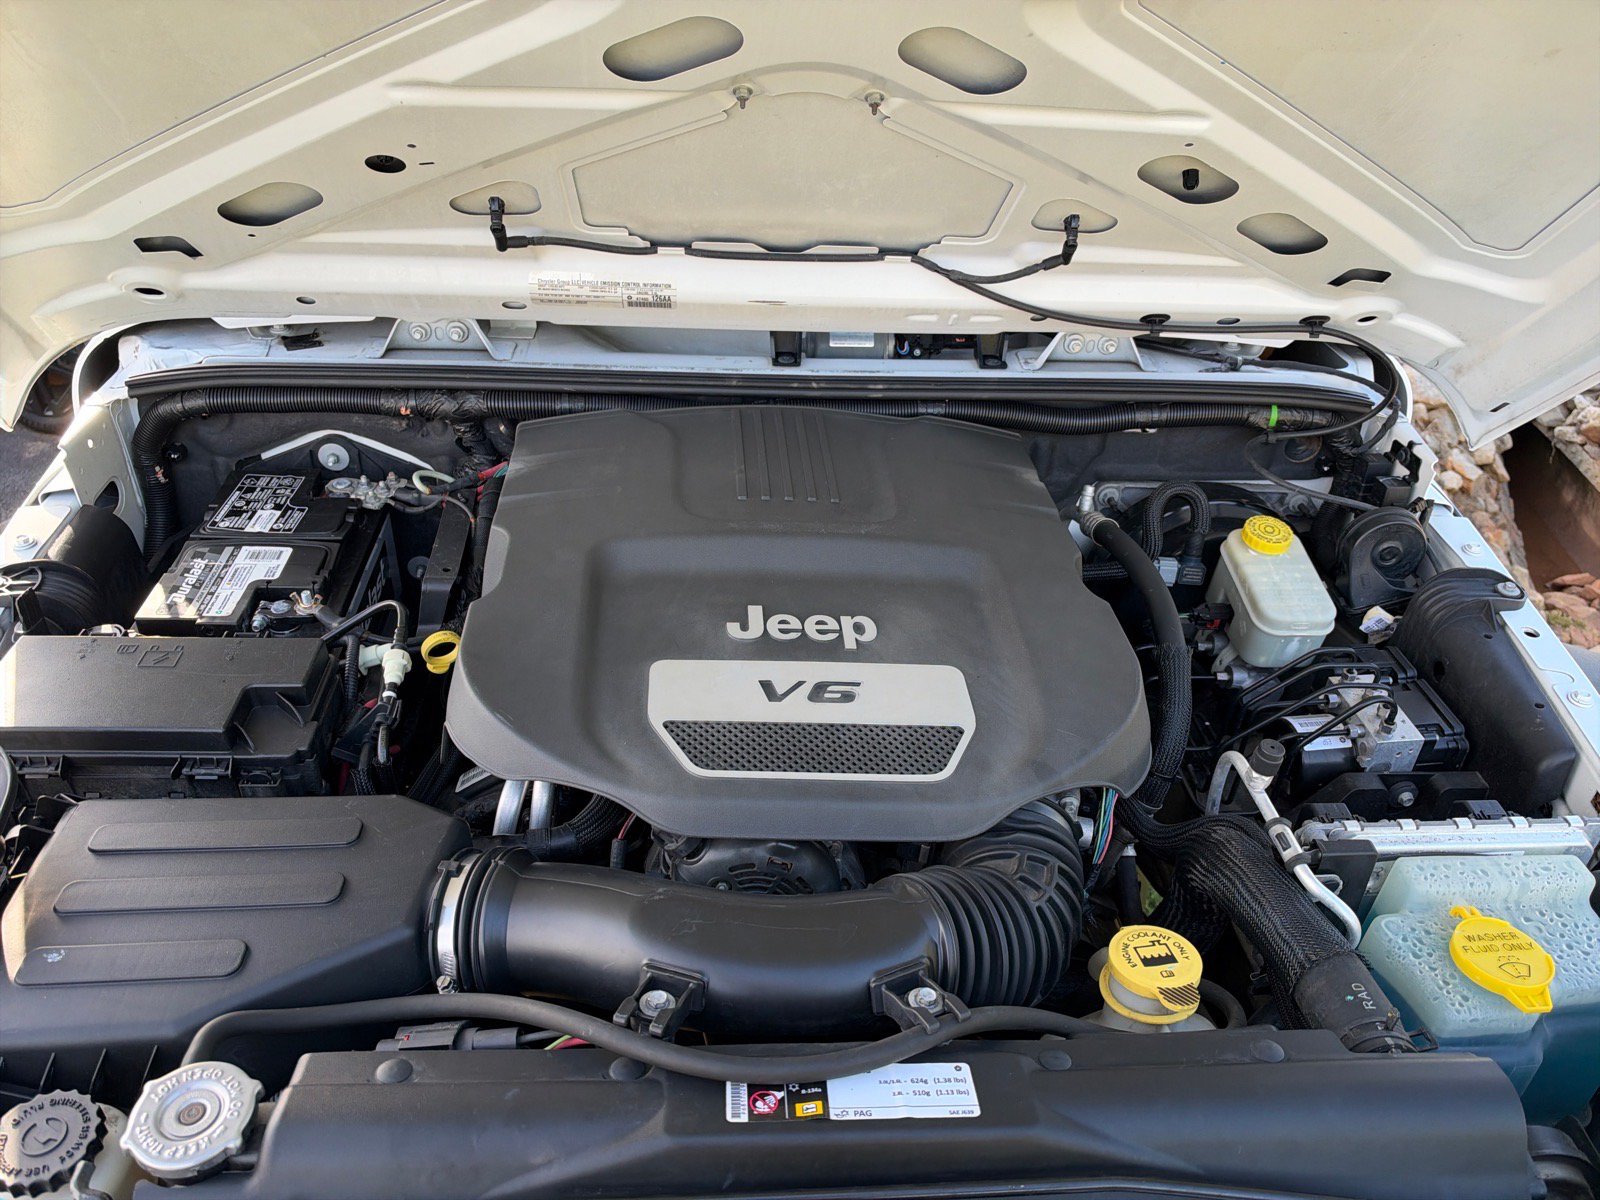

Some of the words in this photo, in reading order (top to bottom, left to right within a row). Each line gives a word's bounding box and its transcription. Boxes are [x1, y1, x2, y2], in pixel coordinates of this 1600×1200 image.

[652, 294, 672, 302] 126AA
[166, 557, 209, 605] Duralast
[726, 604, 877, 650] Jeep
[758, 679, 862, 704] V6
[1127, 931, 1171, 942] COOLANT
[1462, 943, 1500, 954] FLUID
[1502, 941, 1534, 952] ONLY
[1463, 931, 1520, 943] WASHER
[1121, 942, 1138, 968] ENGINE
[1172, 941, 1191, 961] ONLY
[1351, 983, 1377, 1010] RAD
[181, 1067, 223, 1083] OPEN
[910, 1077, 929, 1085] 624g
[933, 1077, 952, 1085] (1.38
[150, 1077, 179, 1102] HOT
[222, 1075, 243, 1098] NOT
[912, 1089, 931, 1097] 510g
[935, 1089, 955, 1097] (1.13
[49, 1097, 91, 1124] STEERING
[226, 1100, 243, 1119] DO
[853, 1109, 873, 1117] PAG
[59, 1126, 91, 1165] POWER
[135, 1124, 165, 1155] TIGHT
[164, 1136, 212, 1158] KEEP
